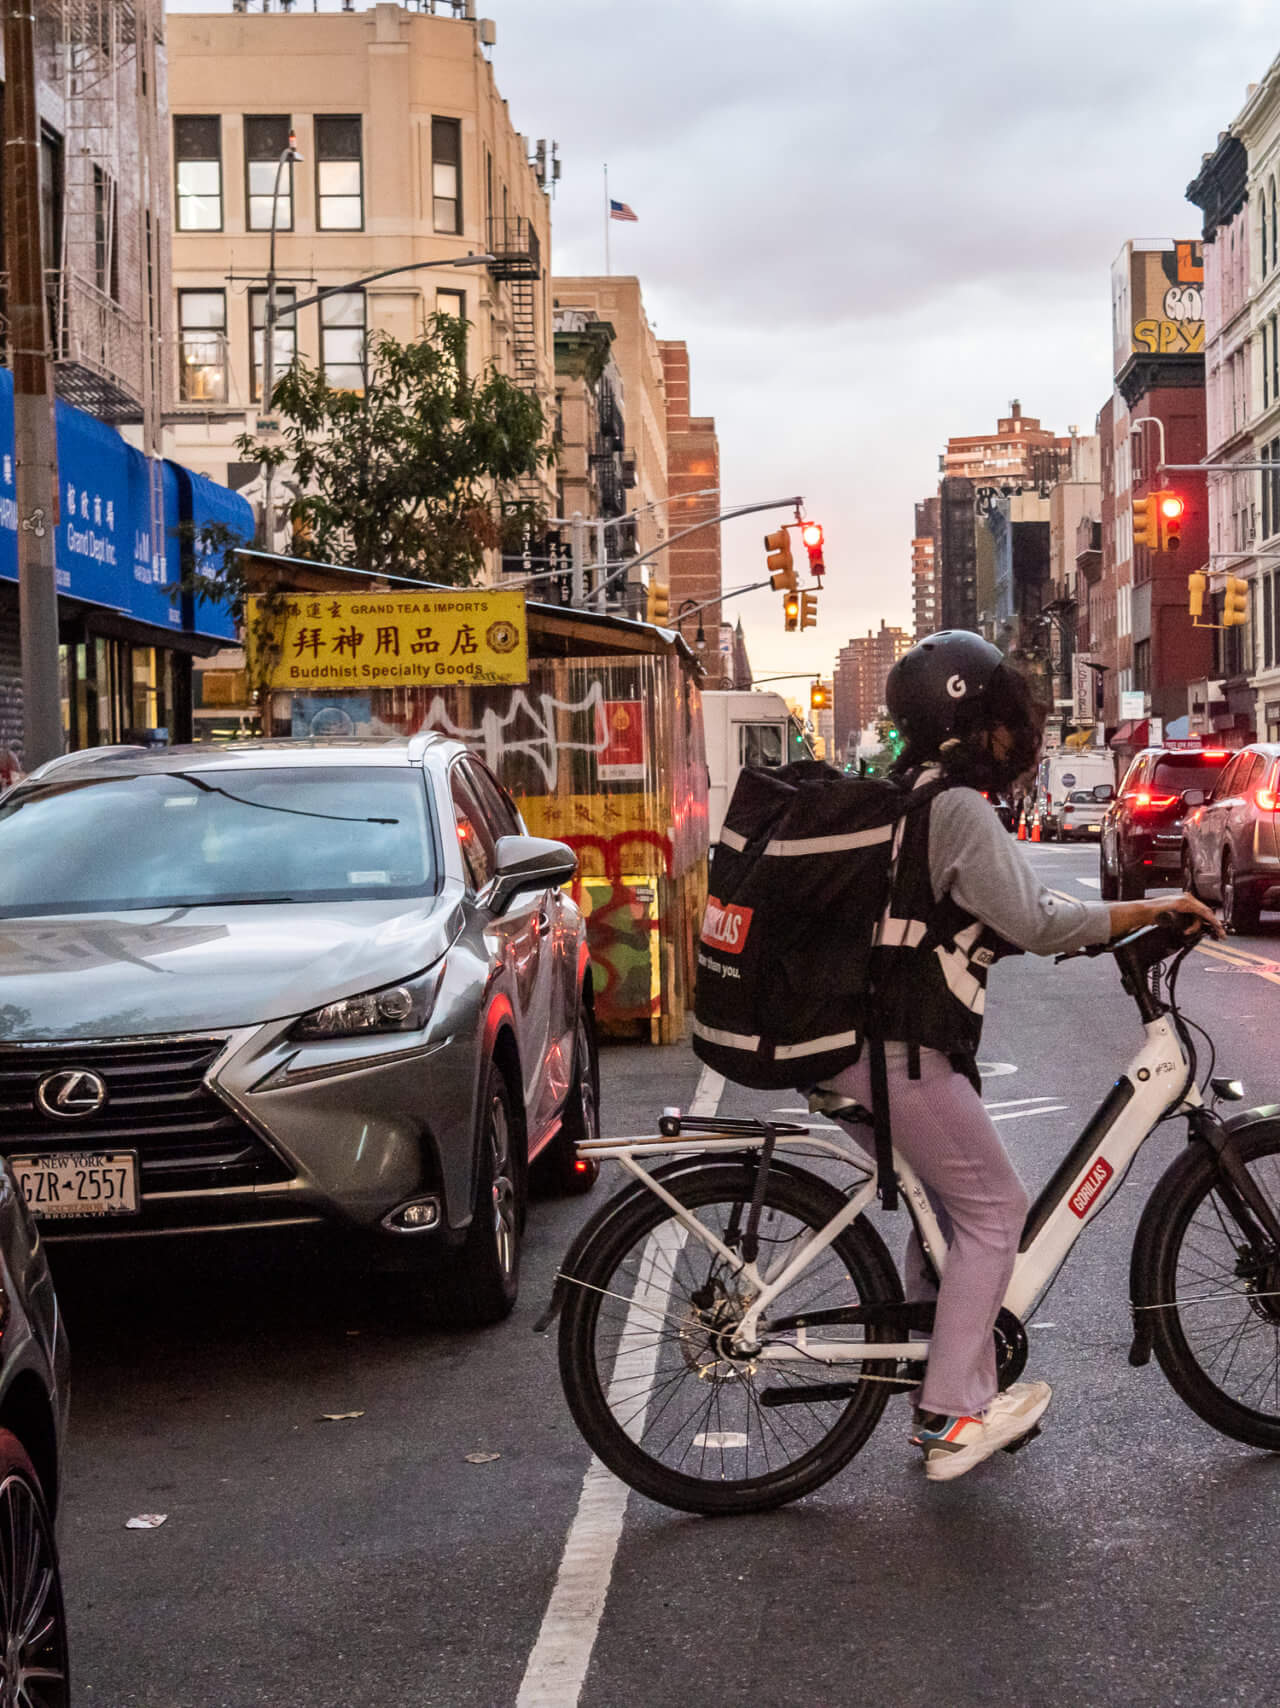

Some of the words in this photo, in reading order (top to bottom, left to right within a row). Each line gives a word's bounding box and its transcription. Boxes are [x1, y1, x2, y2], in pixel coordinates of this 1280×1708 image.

[351, 605, 394, 615] GRAND
[397, 604, 420, 614] TEA
[423, 604, 430, 613] &
[434, 602, 488, 613] IMPORTS
[292, 623, 480, 660] 拜神用品店
[290, 665, 357, 679] Buddhist
[362, 663, 430, 679] Specialty
[435, 662, 483, 675] Goods
[721, 963, 741, 979] you.
[42, 1157, 69, 1170] NEW
[73, 1155, 105, 1168] YORK
[1072, 1164, 1107, 1212] GORILLAS
